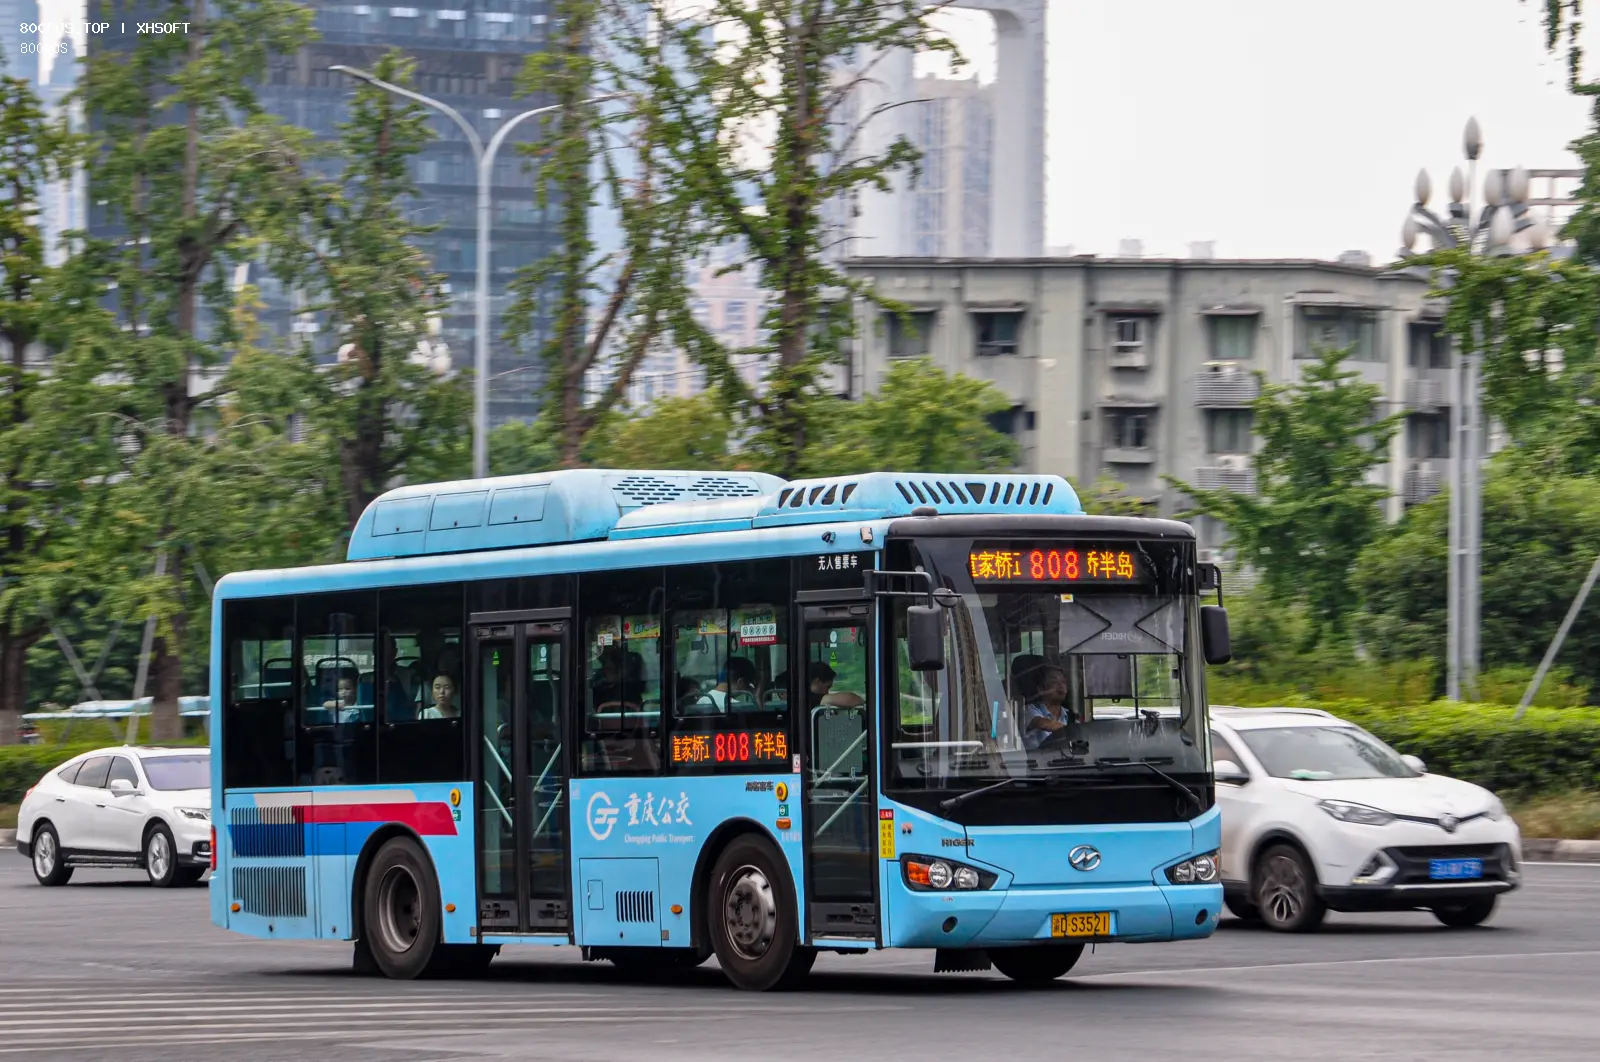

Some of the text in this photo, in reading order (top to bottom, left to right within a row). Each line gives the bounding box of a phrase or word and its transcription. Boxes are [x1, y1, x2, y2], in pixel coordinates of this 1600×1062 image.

[818, 554, 858, 570] 无人售票车
[1030, 550, 1080, 579] 808
[715, 732, 749, 762] 808
[624, 791, 693, 826] 重庆公交
[941, 839, 975, 847] HIGER
